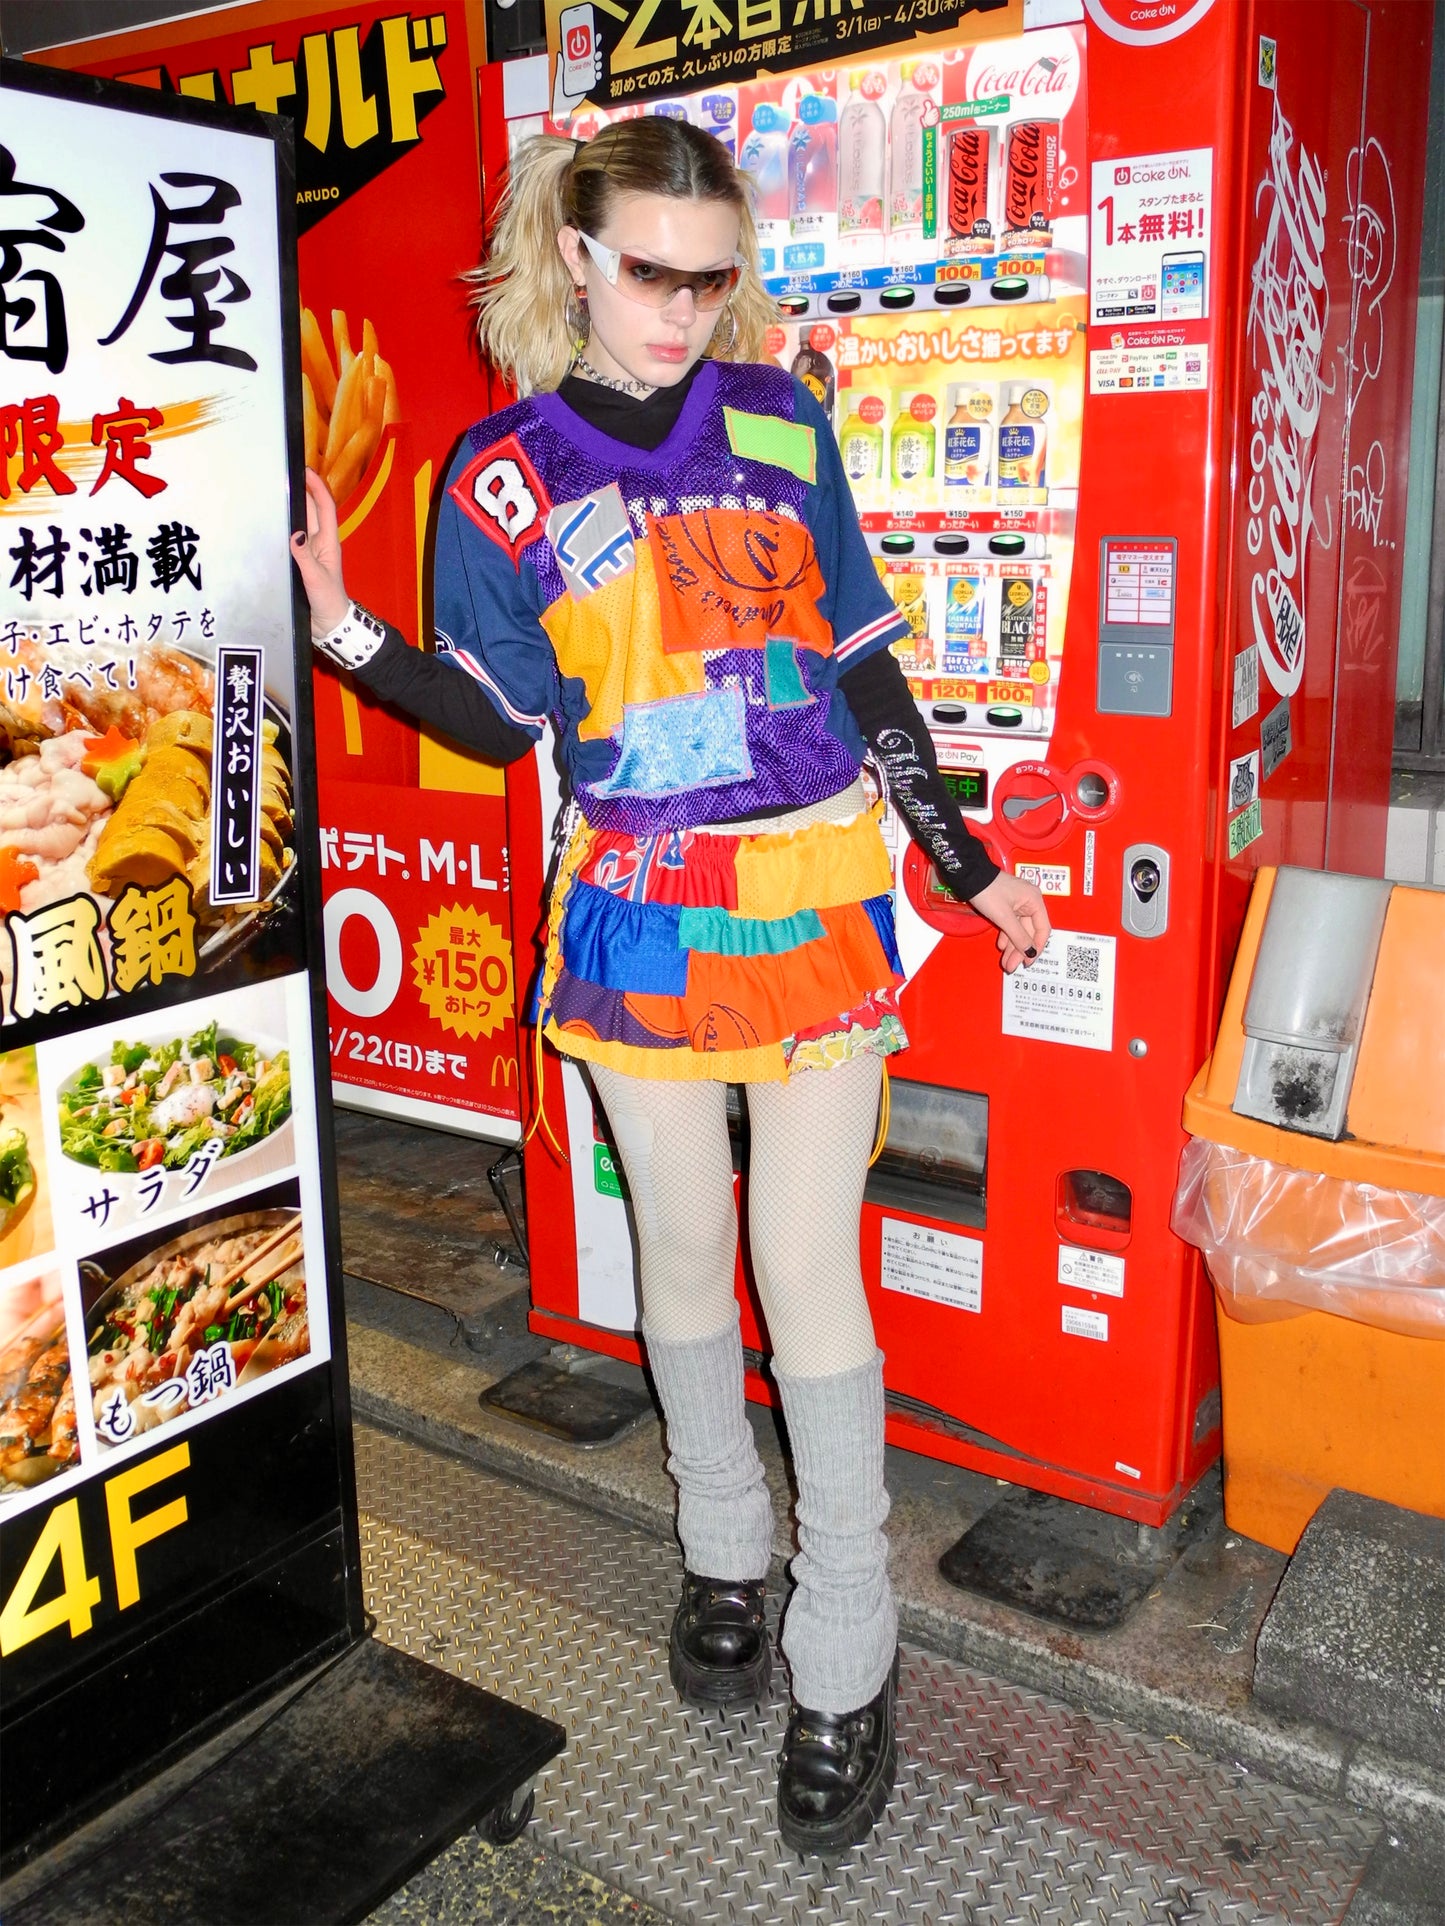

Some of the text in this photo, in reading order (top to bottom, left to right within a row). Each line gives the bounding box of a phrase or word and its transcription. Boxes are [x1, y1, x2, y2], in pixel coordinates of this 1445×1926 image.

[1130, 4, 1176, 21] Coke ON
[835, 17, 881, 40] 3/1(日)
[610, 35, 791, 98] 初めての方、久しぶりの方限定
[973, 55, 1071, 101] Coca-Cola
[1132, 166, 1189, 184] Coke ON
[296, 187, 340, 204] ARUDO
[1138, 192, 1204, 208] スタンプたまると
[1097, 195, 1204, 246] 1本無料!
[842, 270, 860, 279] ¥160
[894, 265, 913, 273] ¥160
[937, 265, 979, 281] 100円
[999, 260, 1041, 275] 100円
[791, 275, 809, 283] ¥120
[838, 328, 1073, 367] 温かいおいしさ揃ってます
[1127, 334, 1185, 346] Coke ON Pay
[1097, 380, 1115, 388] VISA
[896, 510, 914, 518] ¥140
[949, 510, 968, 518] ¥150
[9, 521, 202, 601] 材満載
[1001, 620, 1035, 634] BLACK
[0, 659, 137, 703] け食べて!
[934, 684, 974, 699] 120円
[990, 687, 1031, 703] 100円
[960, 750, 978, 763] Pay
[225, 664, 255, 885] 贅沢おいしい
[1041, 873, 1067, 881] 使えます
[1046, 881, 1062, 892] OK
[6, 874, 198, 1018] 風鍋
[449, 926, 481, 949] 最大
[423, 949, 508, 997] ¥150
[445, 996, 491, 1018] おトク
[81, 1141, 224, 1228] サラダ
[104, 1345, 232, 1436] もつ鍋
[0, 1441, 191, 1657] 4F
